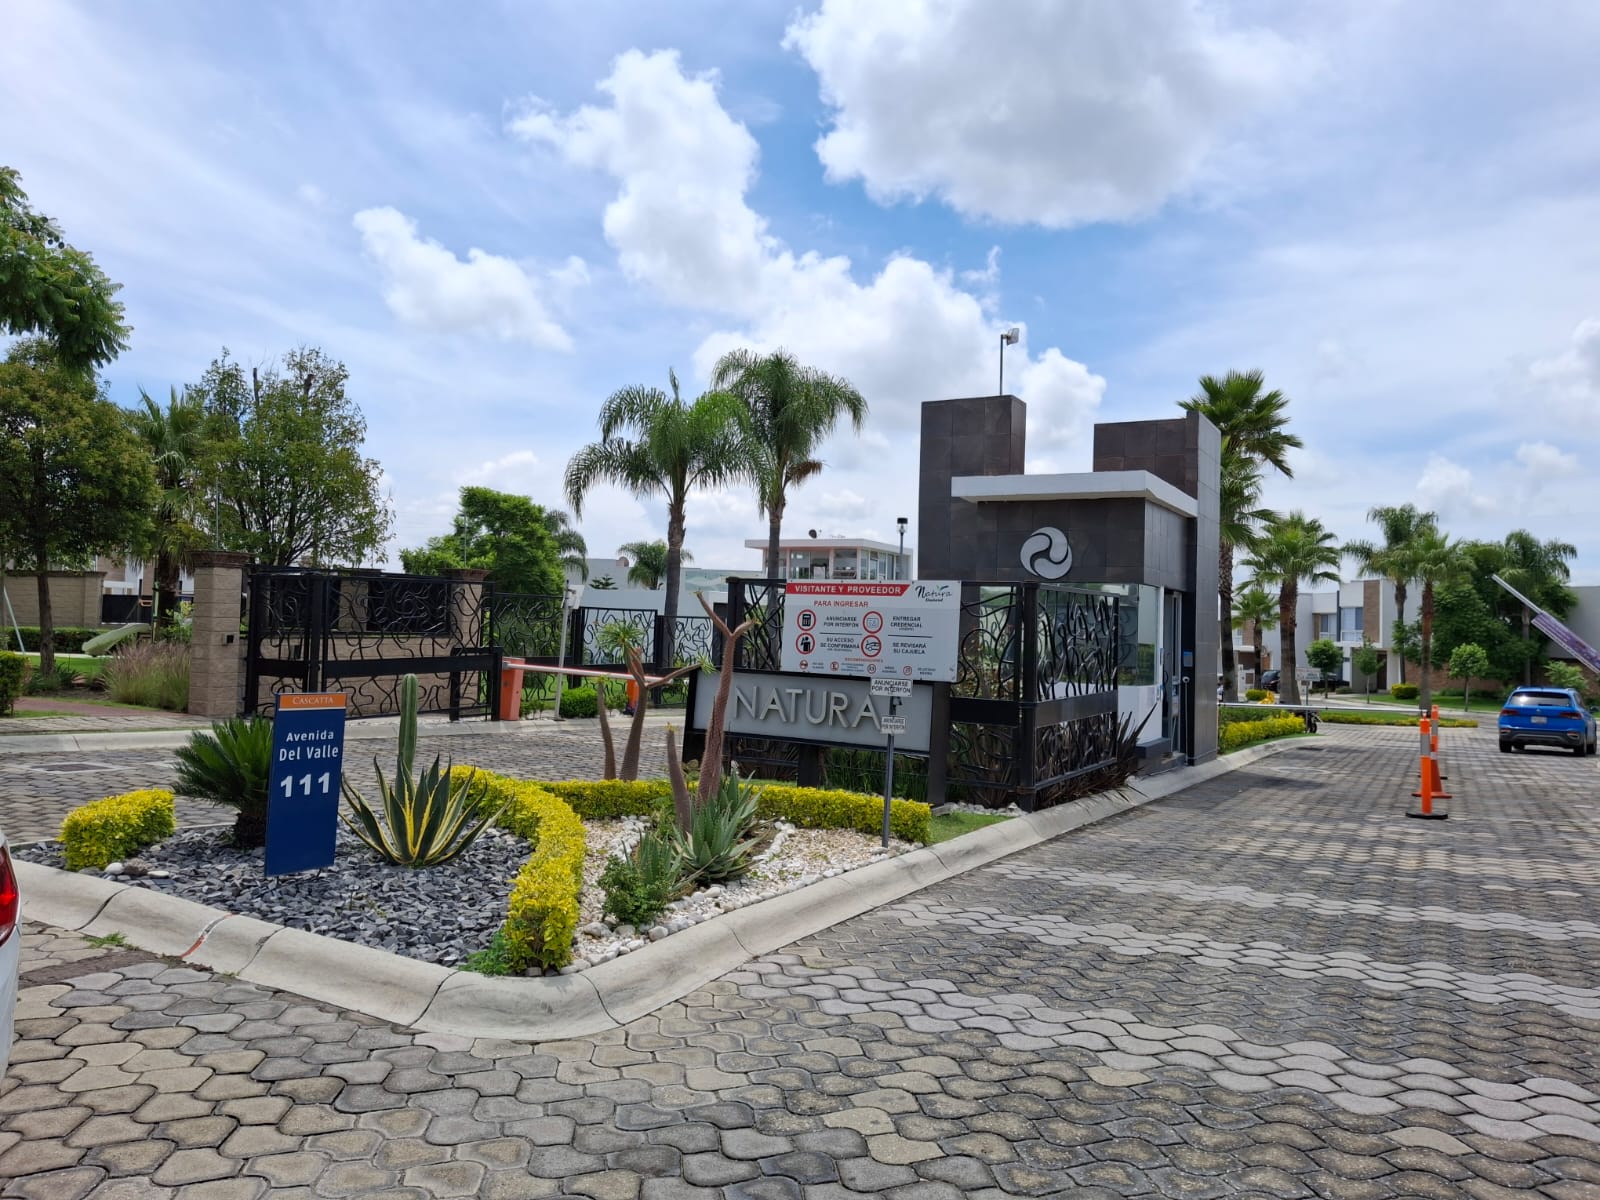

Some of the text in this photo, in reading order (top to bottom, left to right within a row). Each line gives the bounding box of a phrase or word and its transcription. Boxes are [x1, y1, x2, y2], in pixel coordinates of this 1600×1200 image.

[795, 585, 901, 594] VISITANTE Y PROVEEDOR
[292, 696, 334, 705] CASCATTA
[733, 686, 881, 731] NATURA
[286, 730, 334, 742] Avenida
[279, 745, 339, 762] Del Valle
[280, 772, 330, 798] 111
